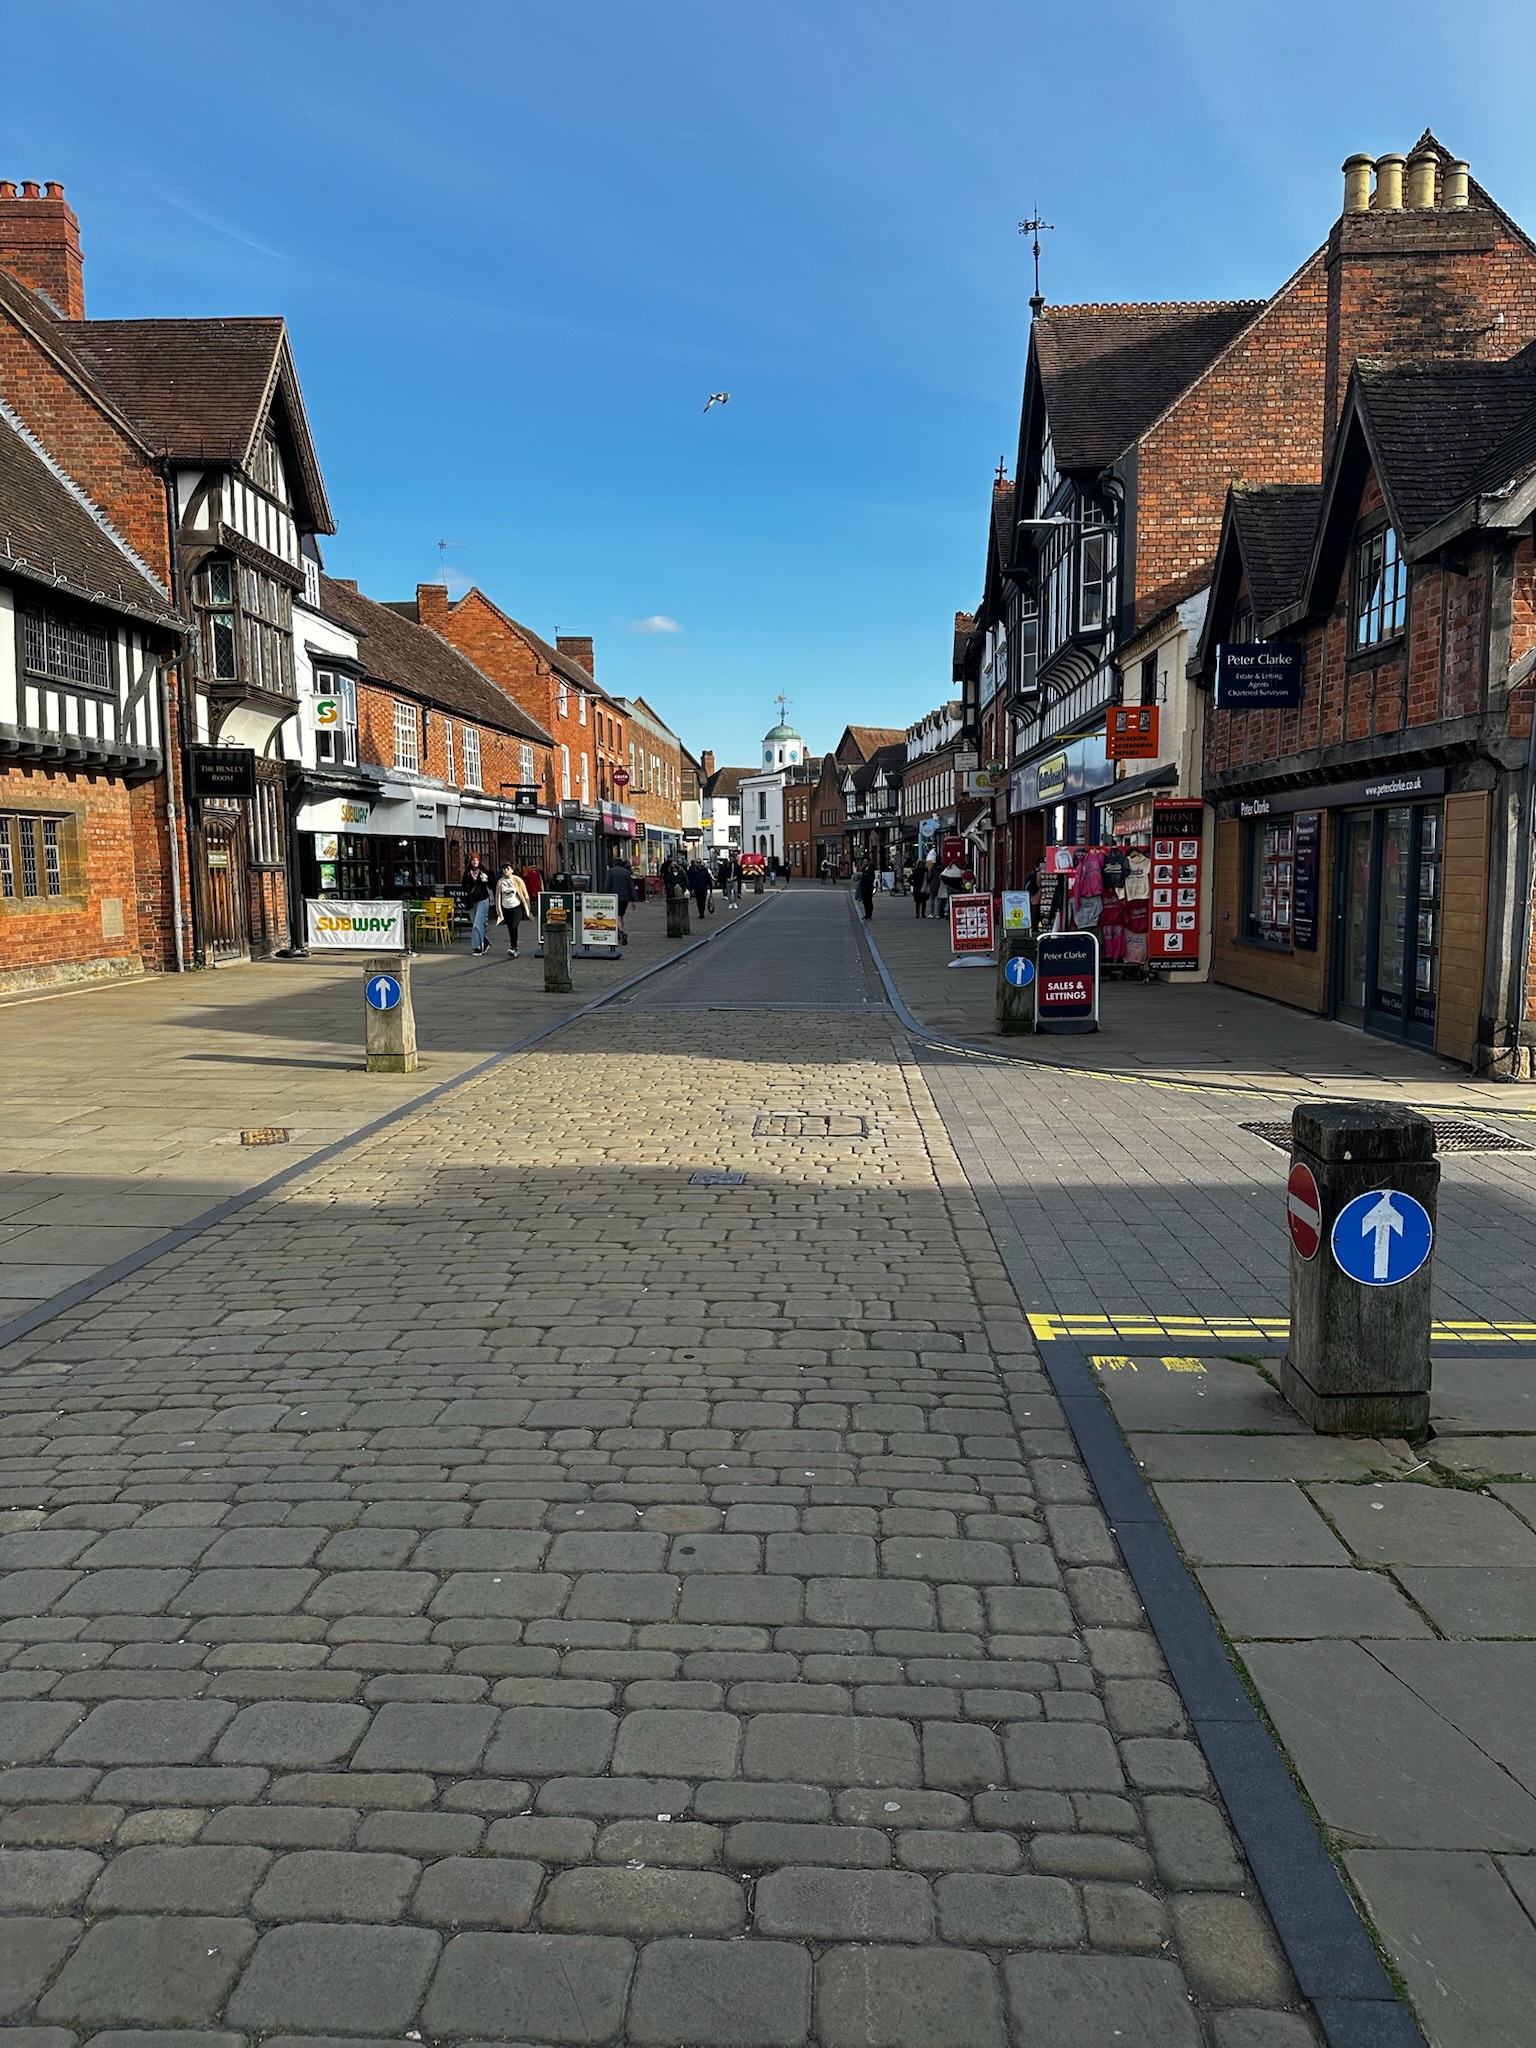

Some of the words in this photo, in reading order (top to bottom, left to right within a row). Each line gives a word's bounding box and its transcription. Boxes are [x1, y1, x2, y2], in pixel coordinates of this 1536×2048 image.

[1227, 655, 1255, 666] Peter
[1257, 653, 1293, 665] Clarke
[1261, 673, 1284, 681] Letting
[1248, 682, 1270, 690] Agents
[1259, 689, 1289, 698] Surveyors
[201, 765, 216, 773] THE
[613, 773, 629, 781] COSTA
[1364, 776, 1422, 798] www.peterclarke.co.uk
[1240, 801, 1254, 817] Peter
[1254, 799, 1270, 816] Clarke
[341, 804, 369, 825] SUBWAY
[1160, 813, 1196, 822] PHONE
[1156, 825, 1180, 834] BITS
[1181, 824, 1189, 834] 4
[1190, 825, 1199, 834] U
[315, 916, 397, 932] SUBWAY
[955, 943, 977, 951] OPEN
[1043, 952, 1062, 961] Peter
[1063, 951, 1087, 960] Clarke
[1047, 981, 1074, 991] SALES
[1076, 981, 1084, 990] &
[1045, 991, 1088, 1001] LETTINGS
